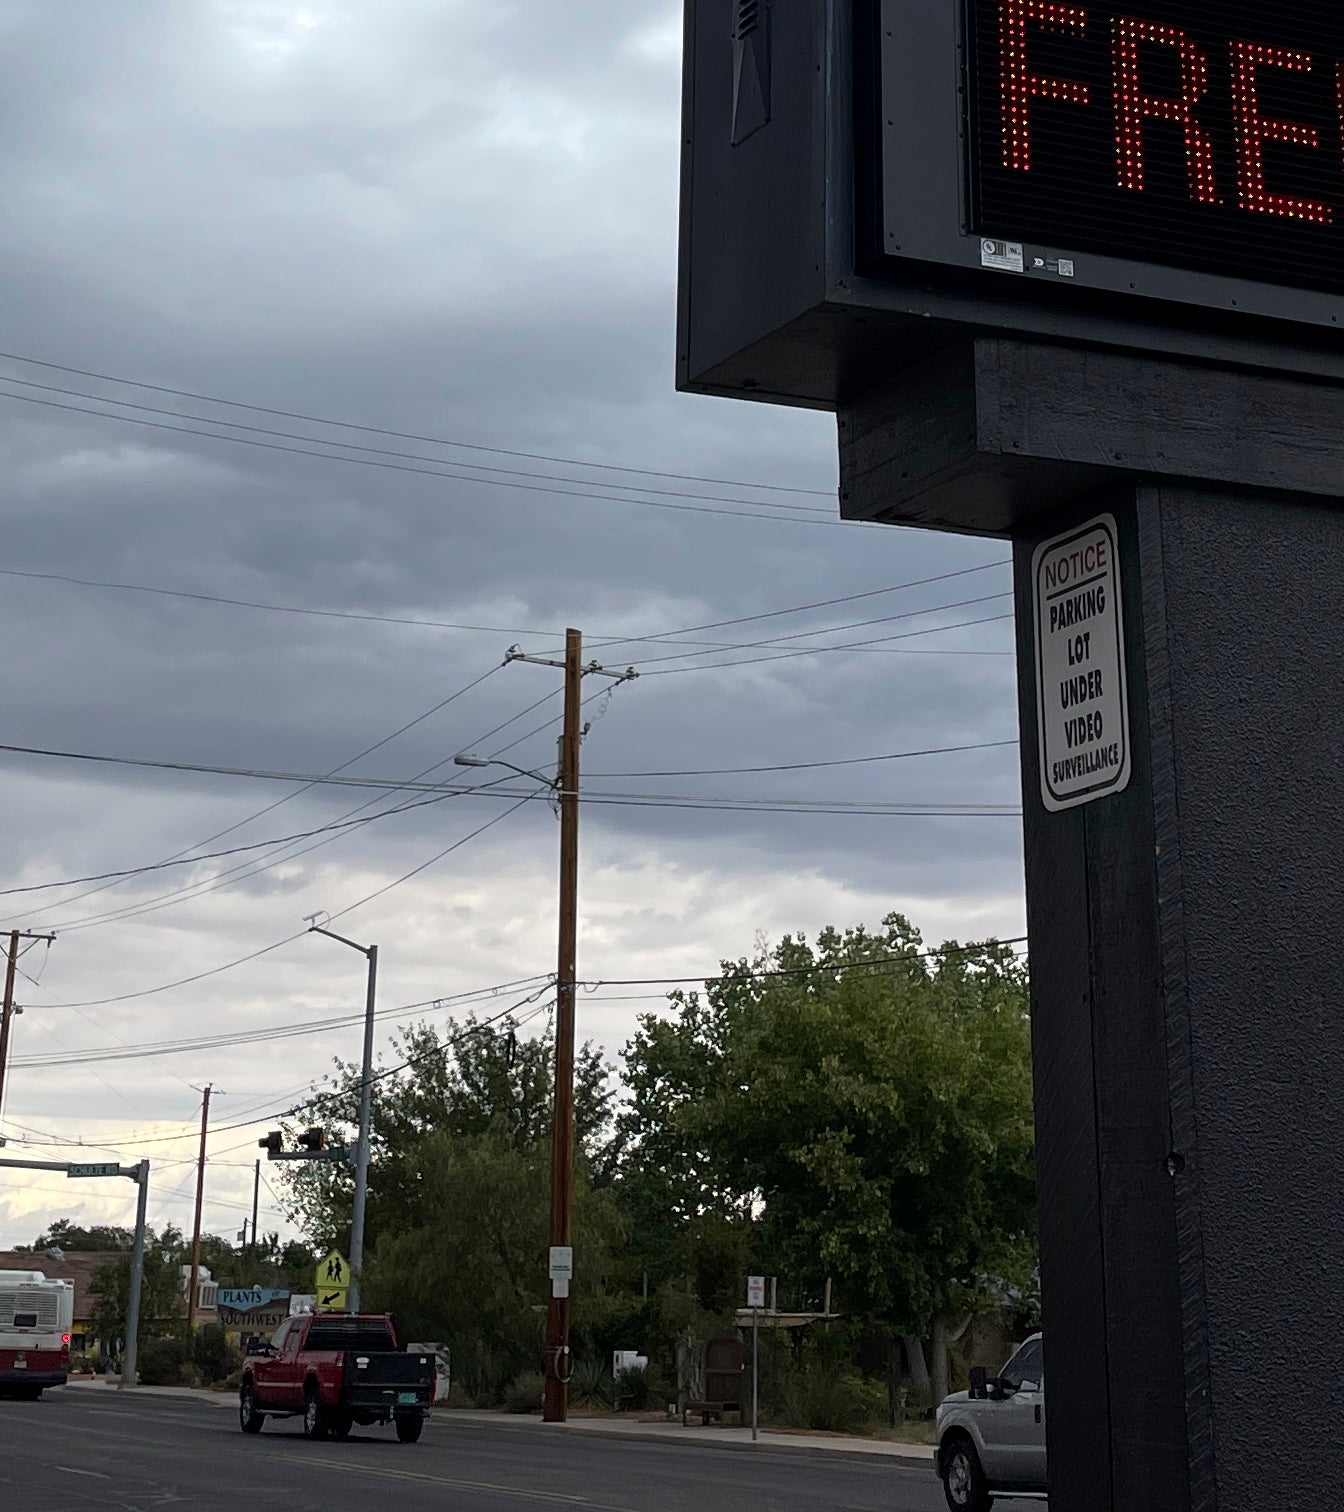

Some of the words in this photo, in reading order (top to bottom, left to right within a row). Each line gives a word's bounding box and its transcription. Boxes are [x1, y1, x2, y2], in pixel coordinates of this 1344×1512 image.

[1045, 539, 1107, 591] NOTICE
[1049, 584, 1106, 634] PARKING
[1067, 631, 1091, 667] LOT
[1060, 668, 1103, 710] UNDER
[1064, 709, 1103, 749] VIDEO
[1052, 742, 1119, 784] SURVEILLANCE
[223, 1290, 262, 1303] PLANTS
[220, 1312, 284, 1326] SOUTHWEST
